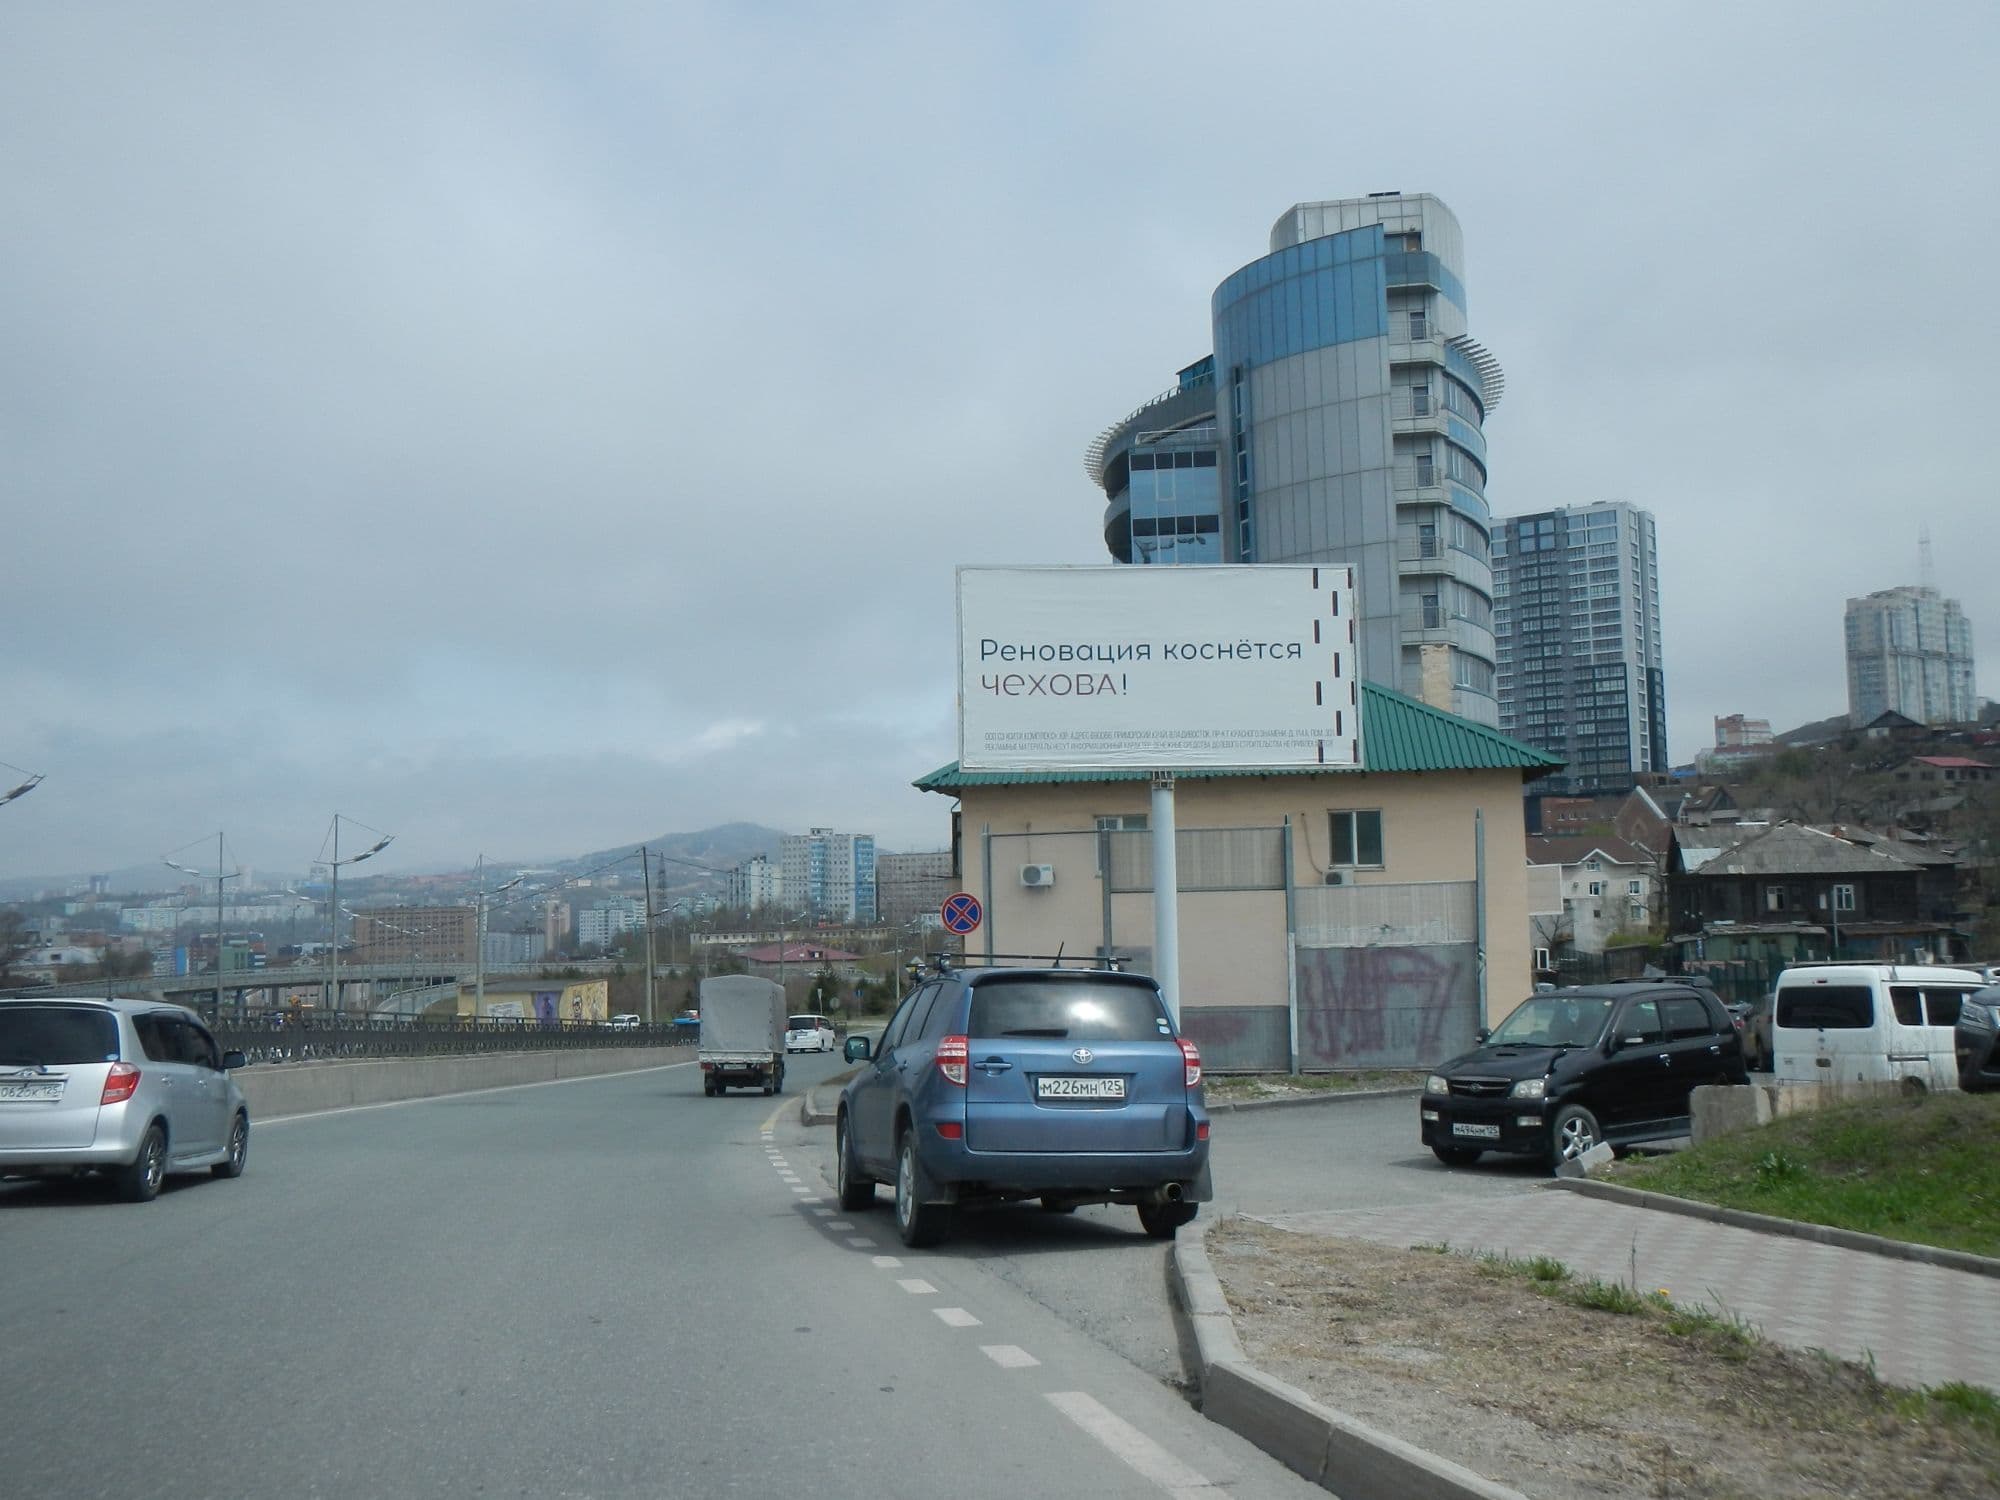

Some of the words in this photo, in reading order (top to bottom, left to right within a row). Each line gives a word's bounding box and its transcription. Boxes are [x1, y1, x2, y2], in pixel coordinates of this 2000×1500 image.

[981, 639, 1151, 663] Реновация
[1164, 639, 1302, 660] коснётся
[1041, 1080, 1098, 1095] М226МН
[1101, 1080, 1123, 1092] 125
